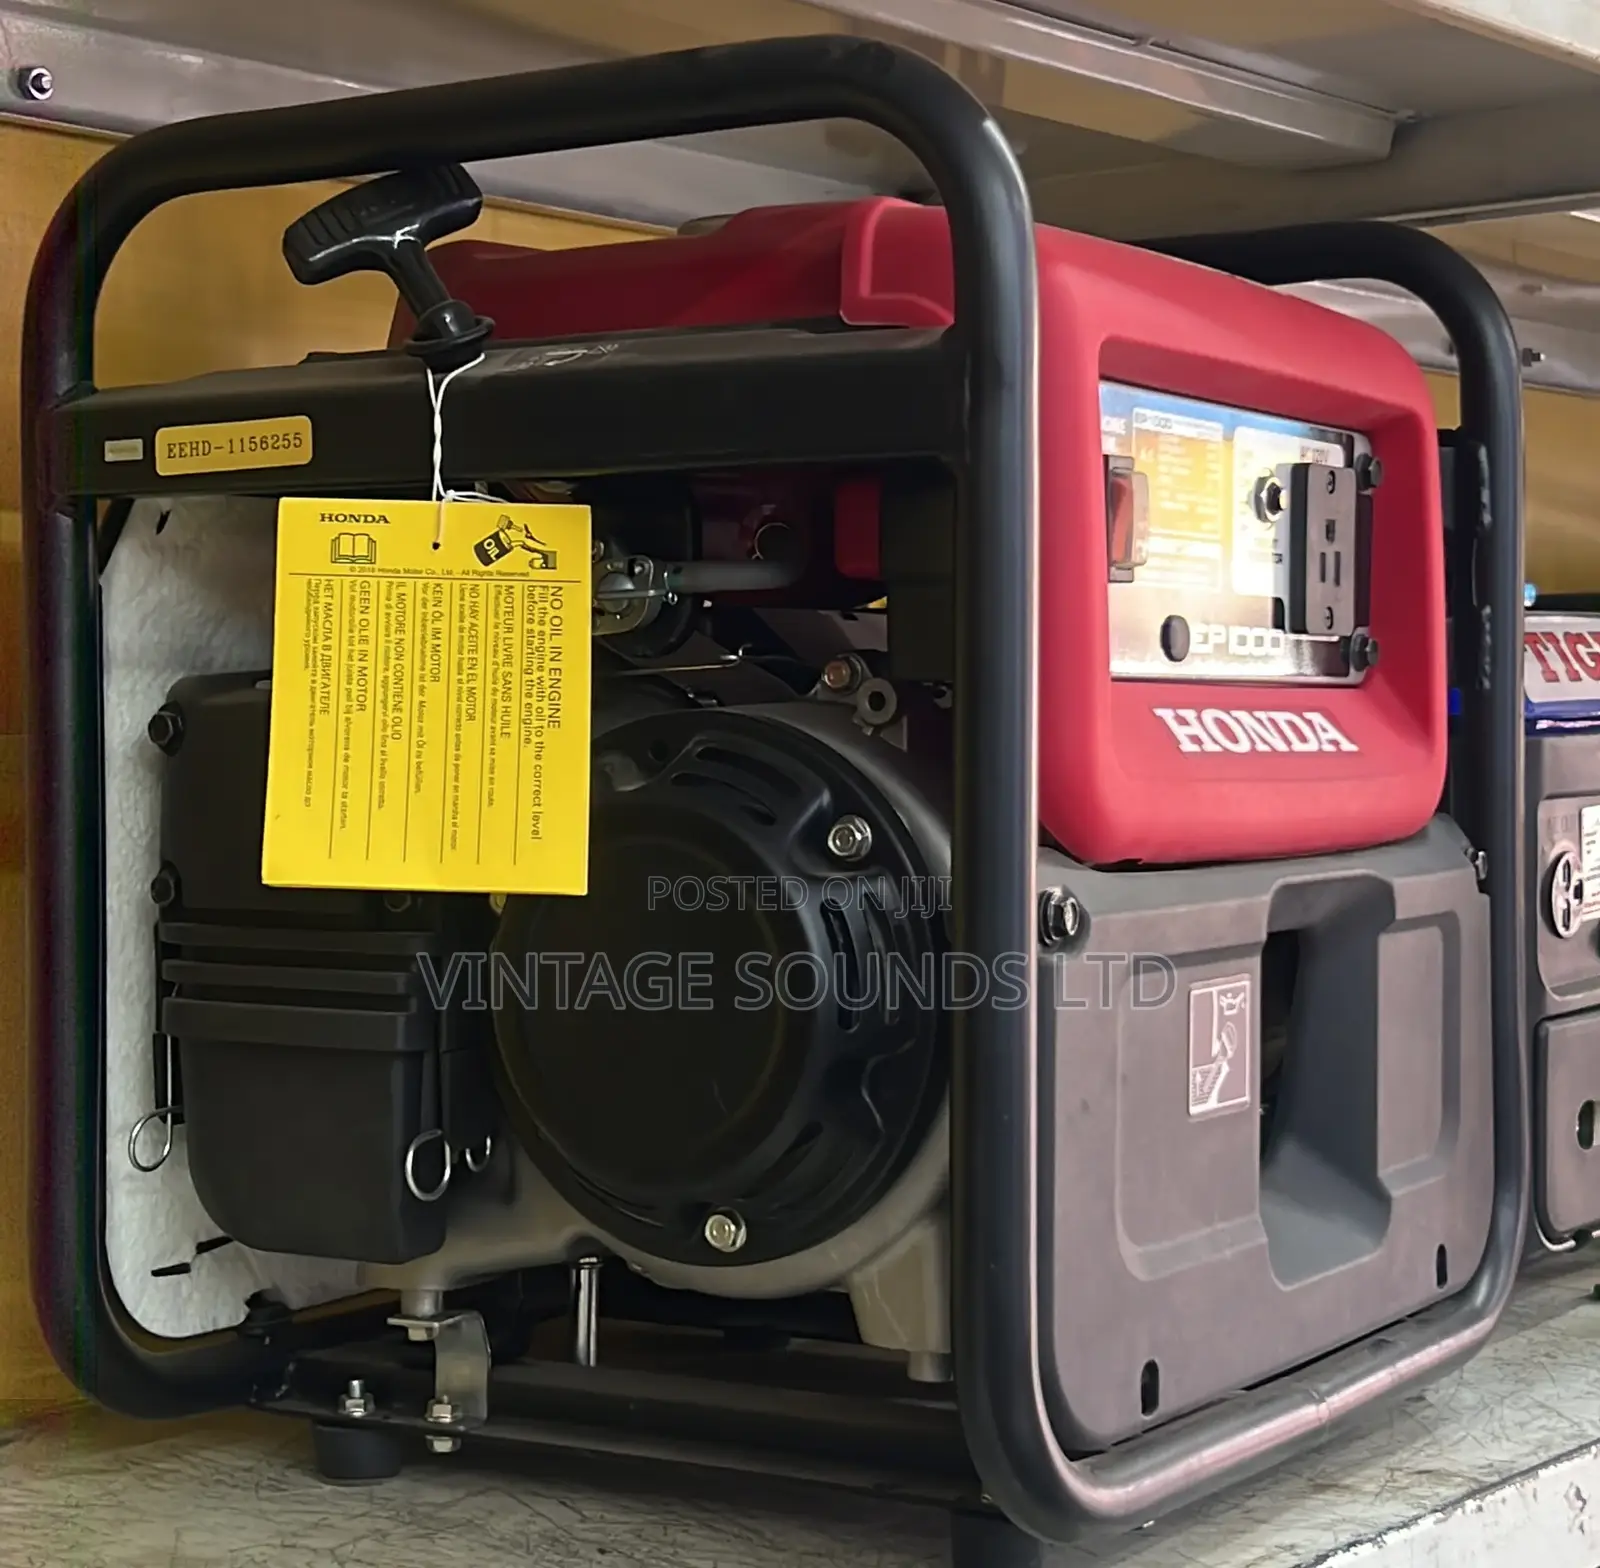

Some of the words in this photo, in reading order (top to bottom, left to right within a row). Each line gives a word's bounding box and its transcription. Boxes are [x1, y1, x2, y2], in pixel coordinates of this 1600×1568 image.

[167, 432, 303, 459] EEHD-1156255
[319, 512, 390, 524] HONDA
[483, 538, 501, 561] OIL
[378, 567, 401, 575] Honda
[323, 579, 334, 599] НЕТ
[358, 580, 370, 614] GEEN
[395, 581, 406, 589] IL
[431, 583, 442, 607] KEIN
[468, 583, 479, 598] NO
[538, 585, 548, 602] Fill
[550, 585, 563, 609] NO
[394, 592, 406, 635] MOTORE
[431, 610, 444, 624] ÖL
[468, 600, 479, 620] HAY
[503, 585, 514, 633] MOTEUR
[526, 585, 537, 624] before
[537, 607, 547, 626] the
[321, 601, 333, 641] МАСЛА
[357, 618, 369, 645] OLIE
[430, 627, 441, 640] IM
[549, 615, 562, 641] OIL
[393, 637, 405, 661] NON
[467, 622, 478, 654] ACEITE
[524, 628, 536, 675] starting
[534, 630, 547, 672] engine
[1190, 623, 1284, 656] EP1000
[357, 649, 368, 661] IN
[429, 643, 441, 682] MOTOR
[466, 657, 477, 669] EN
[502, 637, 513, 667] LIVRE
[549, 646, 562, 661] IN
[1524, 631, 1600, 682] TIG
[317, 653, 331, 715] ДВИГАТЕЛЕ
[355, 665, 367, 711] MOTOR
[391, 663, 404, 713] CONTIENE
[466, 673, 477, 684] EL
[501, 671, 512, 702] SANS
[525, 679, 534, 697] the
[535, 675, 546, 702] with
[465, 686, 476, 721] MOTOR
[547, 667, 561, 728] ENGINE
[500, 705, 511, 738] HUILE
[521, 702, 534, 748] engine.
[535, 706, 545, 721] oil
[390, 716, 402, 740] OLIO
[534, 725, 544, 737] to
[1152, 708, 1359, 753] HONDA
[533, 741, 544, 760] the
[532, 764, 543, 807] correct
[530, 811, 542, 840] level
